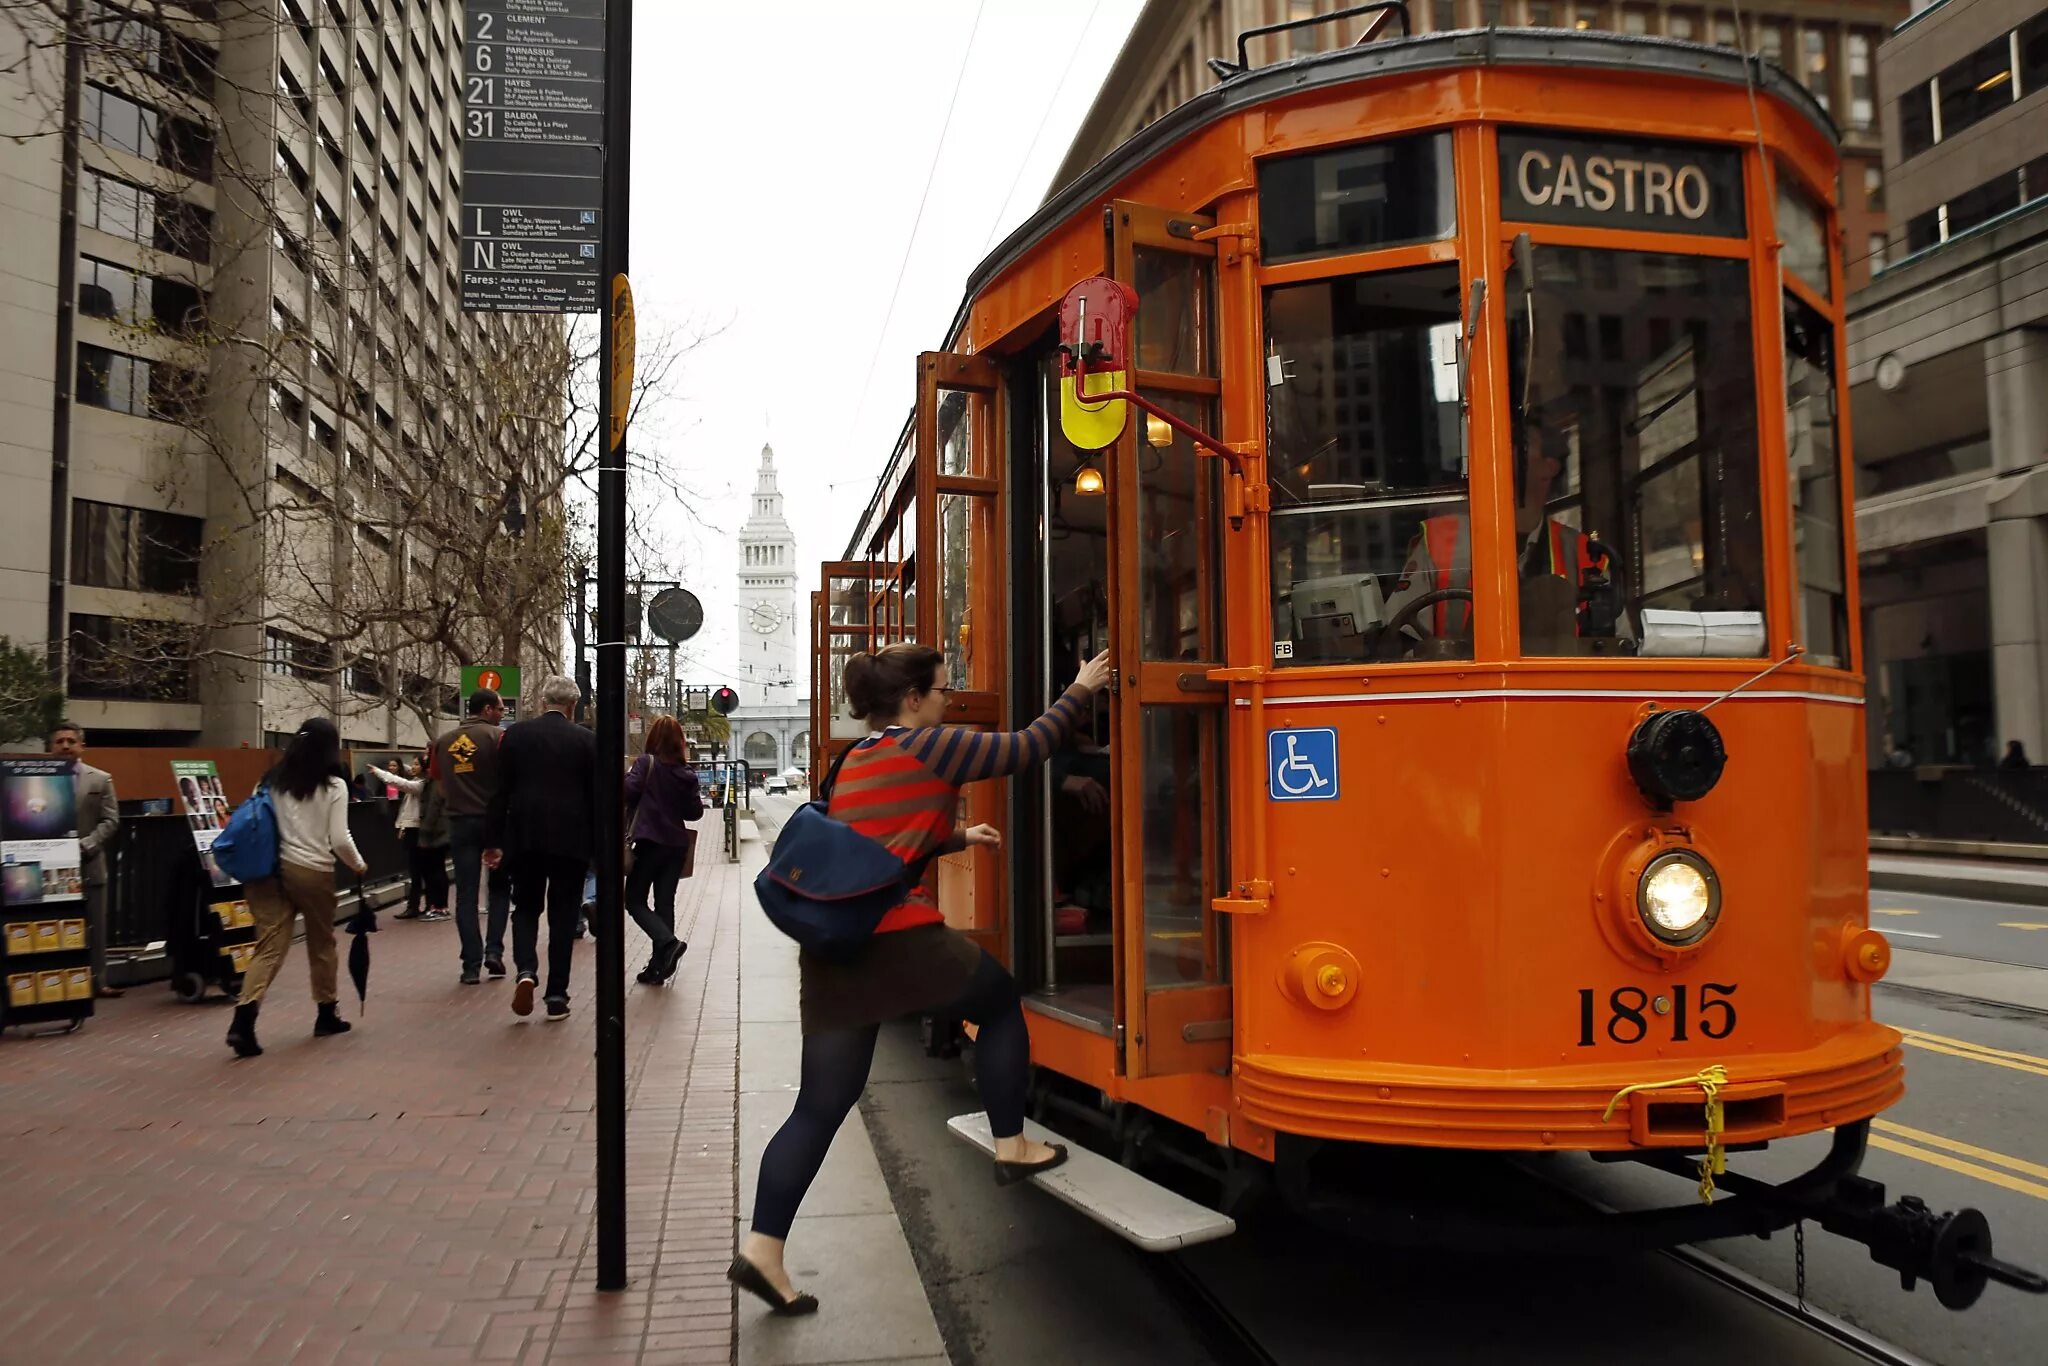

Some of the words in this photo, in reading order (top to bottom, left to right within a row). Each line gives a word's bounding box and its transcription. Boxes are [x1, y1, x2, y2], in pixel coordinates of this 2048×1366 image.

[477, 13, 493, 39] 2
[507, 15, 546, 23] CLEMENT
[476, 45, 491, 71] 6
[506, 47, 554, 56] PARNASSUS
[468, 78, 494, 104] 21
[467, 111, 493, 137] 31
[1518, 149, 1710, 220] CASTRO
[476, 208, 491, 235] L
[473, 242, 496, 269] N
[465, 275, 498, 284] Fares:
[1275, 644, 1292, 655] FB
[1576, 983, 1738, 1047] 1815
